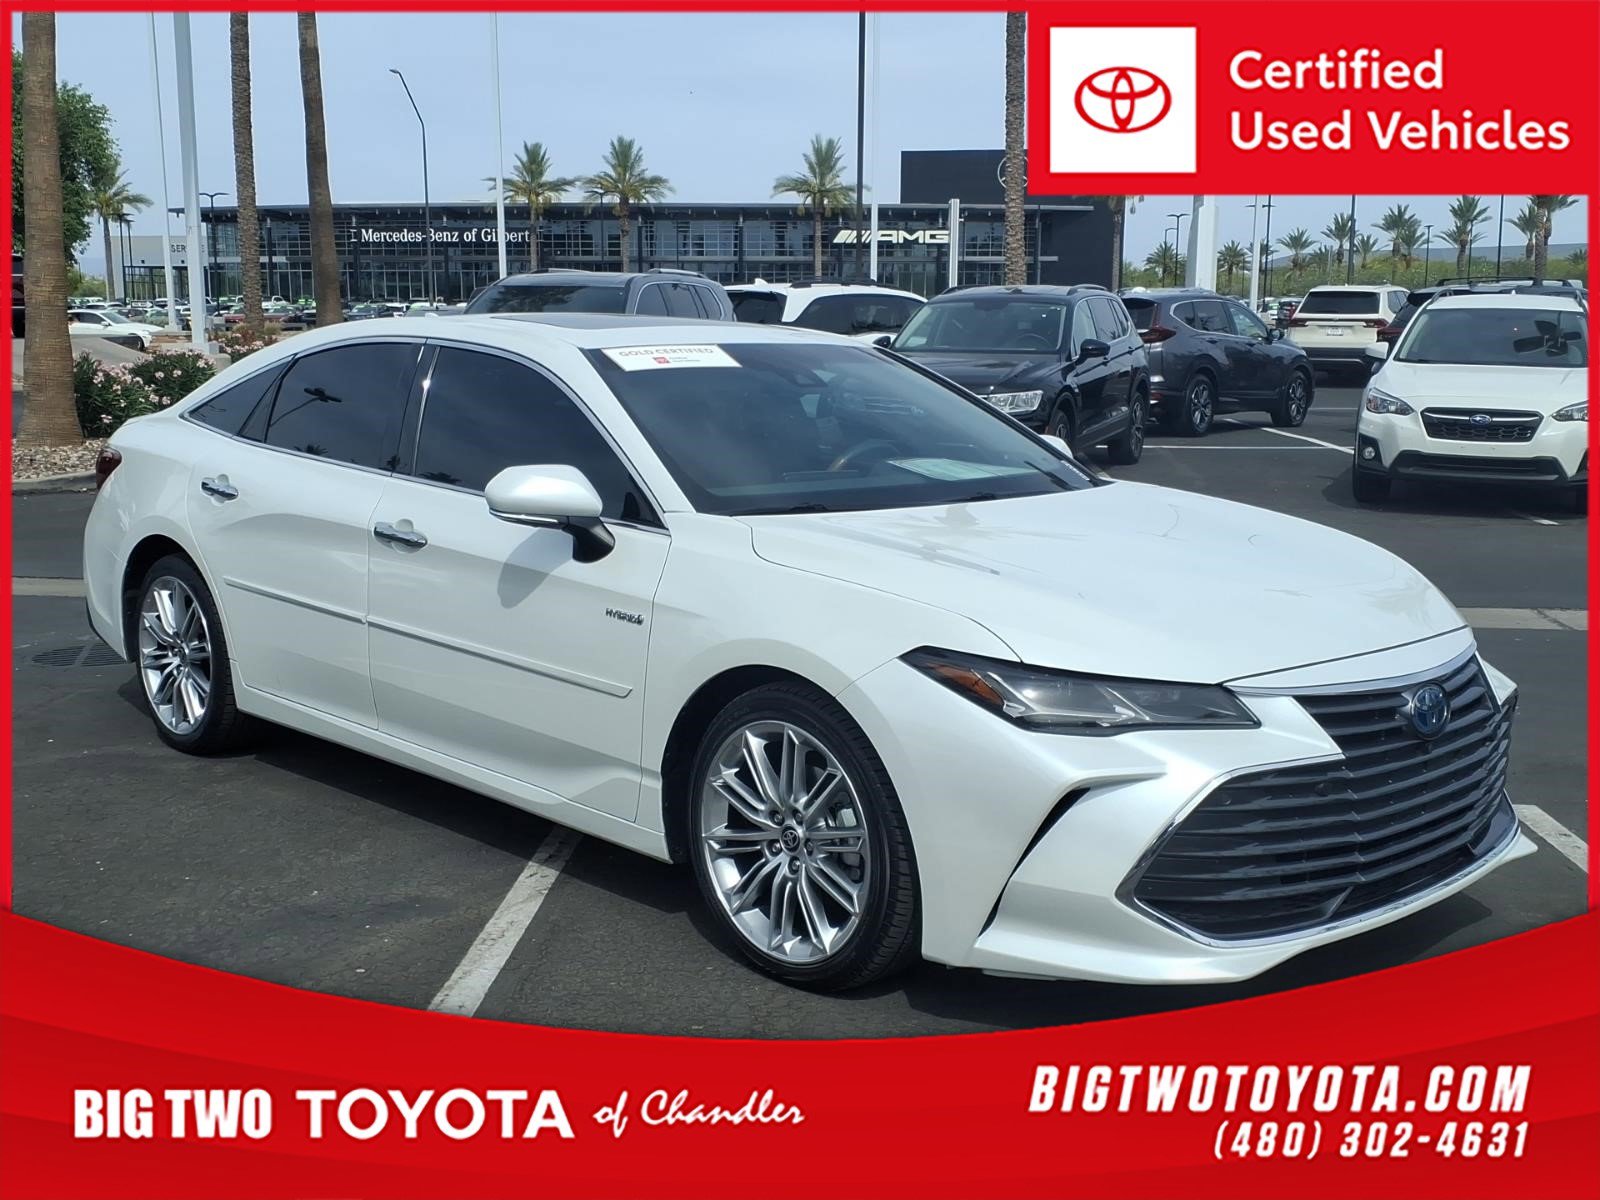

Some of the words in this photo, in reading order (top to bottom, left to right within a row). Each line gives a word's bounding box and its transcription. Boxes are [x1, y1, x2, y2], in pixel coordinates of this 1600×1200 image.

[361, 227, 459, 242] Mercedes-Benz
[463, 228, 478, 242] of
[876, 230, 950, 244] AMG
[655, 347, 714, 355] CERTIFIED
